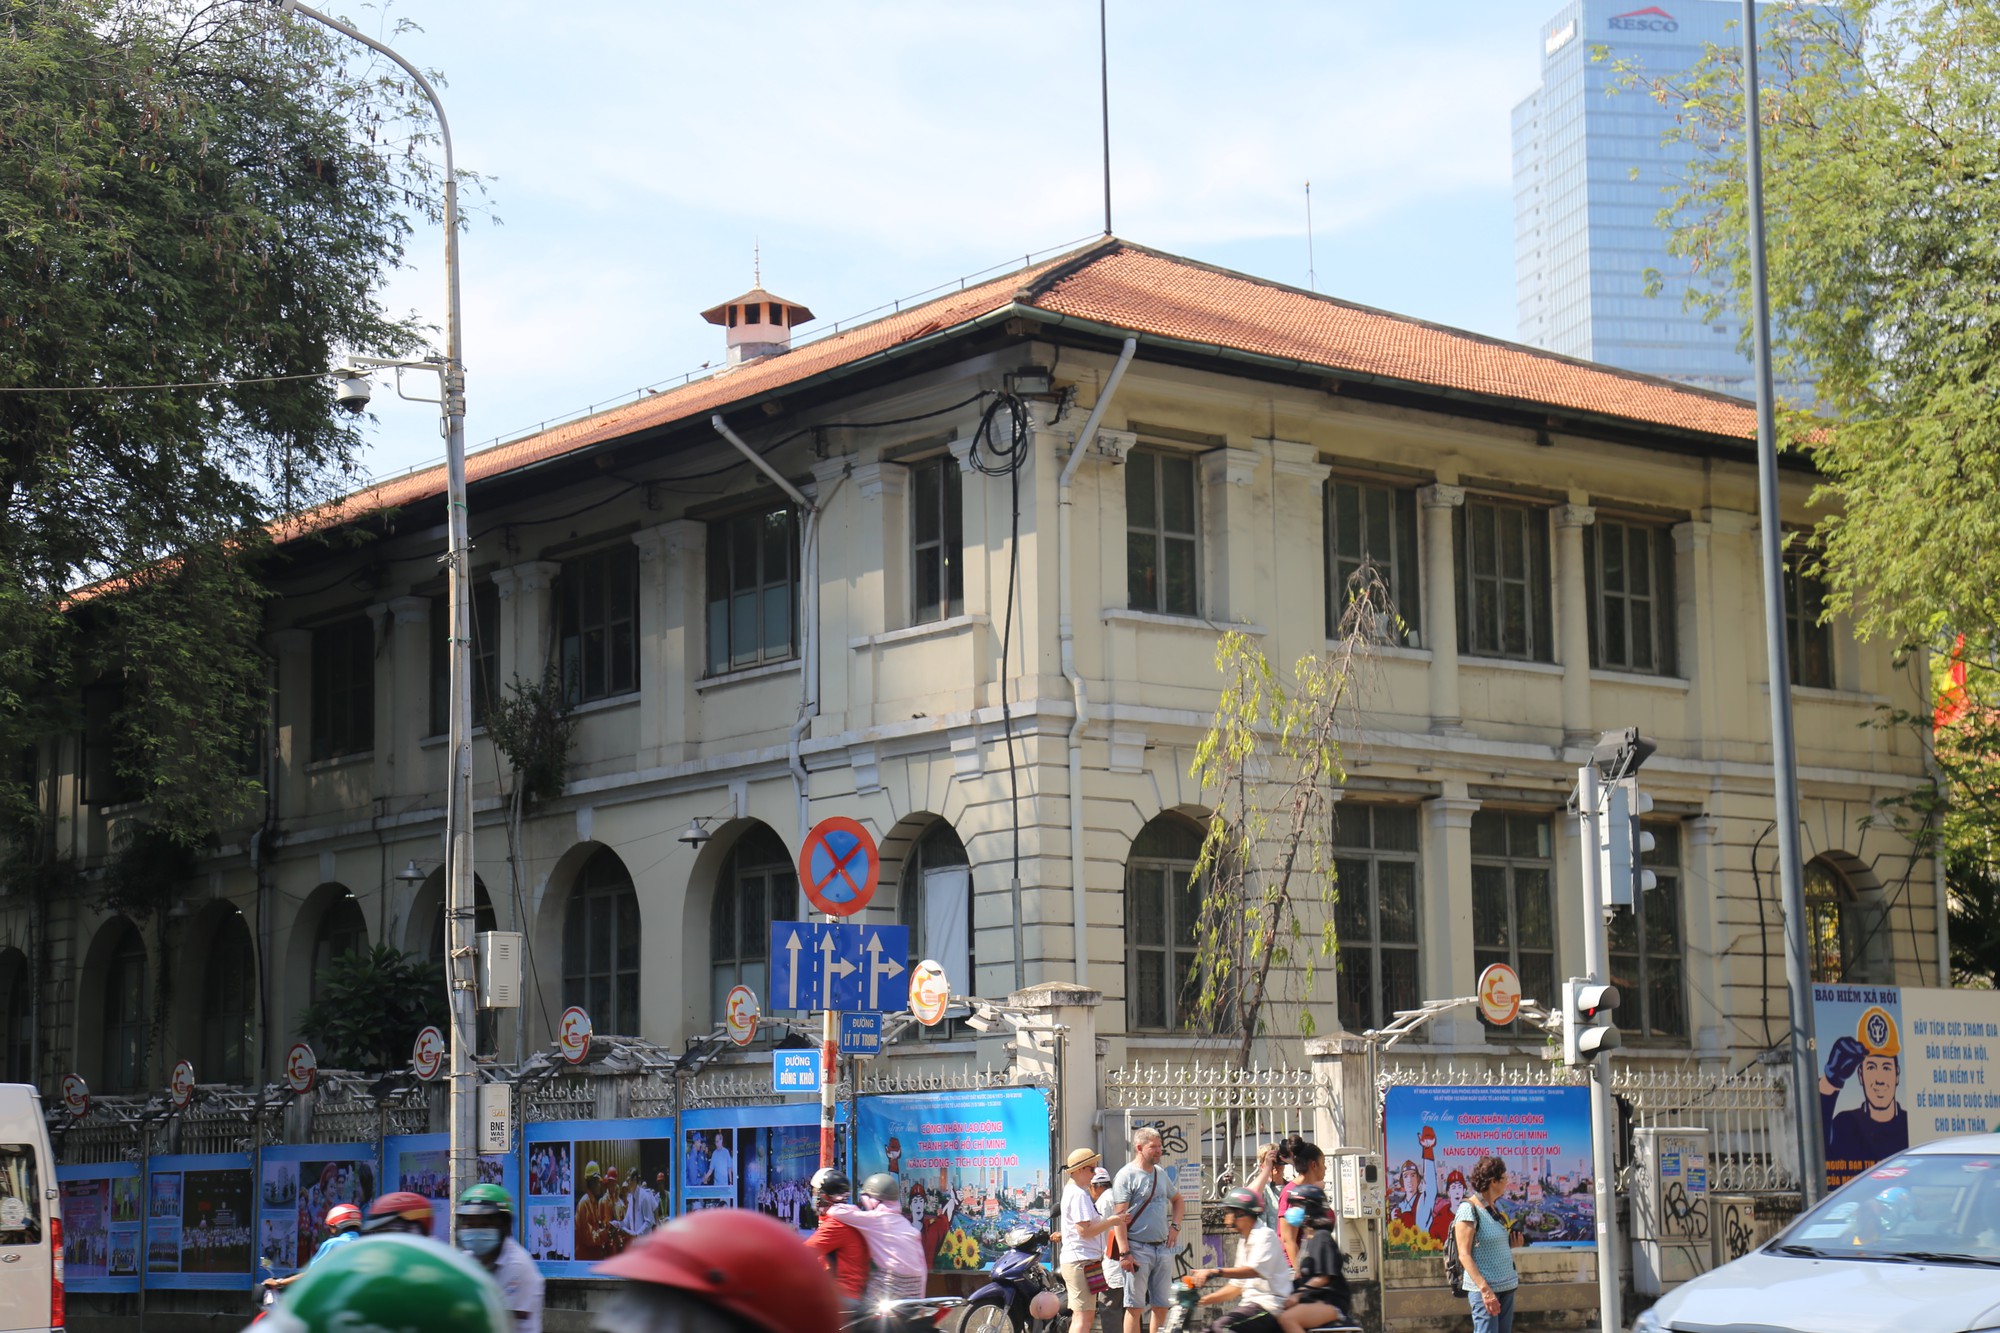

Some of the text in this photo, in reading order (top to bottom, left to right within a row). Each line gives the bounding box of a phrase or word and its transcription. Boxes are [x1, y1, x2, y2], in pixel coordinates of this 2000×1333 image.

[1608, 17, 1679, 32] RESCO
[853, 1018, 874, 1028] ĐƯỜNG
[1929, 1019, 1945, 1036] TÍCH
[1963, 1022, 1984, 1037] THAM
[1986, 1023, 1998, 1037] GIA
[844, 1030, 851, 1047] LÝ
[862, 1033, 878, 1049] TRỌNG
[785, 1055, 810, 1066] ĐƯỜNG
[1970, 1070, 1975, 1084] Y
[1984, 1090, 2000, 1108] SỐN
[1458, 1112, 1544, 1126] CÔNG NHÂN LAO ĐỘNG
[1935, 1117, 1949, 1132] CHO
[490, 1122, 505, 1131] BNE
[921, 1120, 1002, 1134] CÔNG NHÂN LAO ĐỘNG
[1455, 1129, 1482, 1140] THÀNH
[1483, 1127, 1500, 1140] PHỐ
[1513, 1128, 1526, 1140] CHÍ
[1527, 1131, 1548, 1140] MINH
[918, 1139, 942, 1151] THÀNH
[943, 1136, 959, 1151] PHỐ
[972, 1137, 985, 1150] CHÍ
[986, 1139, 1006, 1150] MINH
[1466, 1145, 1490, 1157] ĐỘNG
[1496, 1145, 1513, 1156] TÍCH
[928, 1157, 949, 1169] ĐỘNG
[955, 1154, 971, 1168] TÍCH
